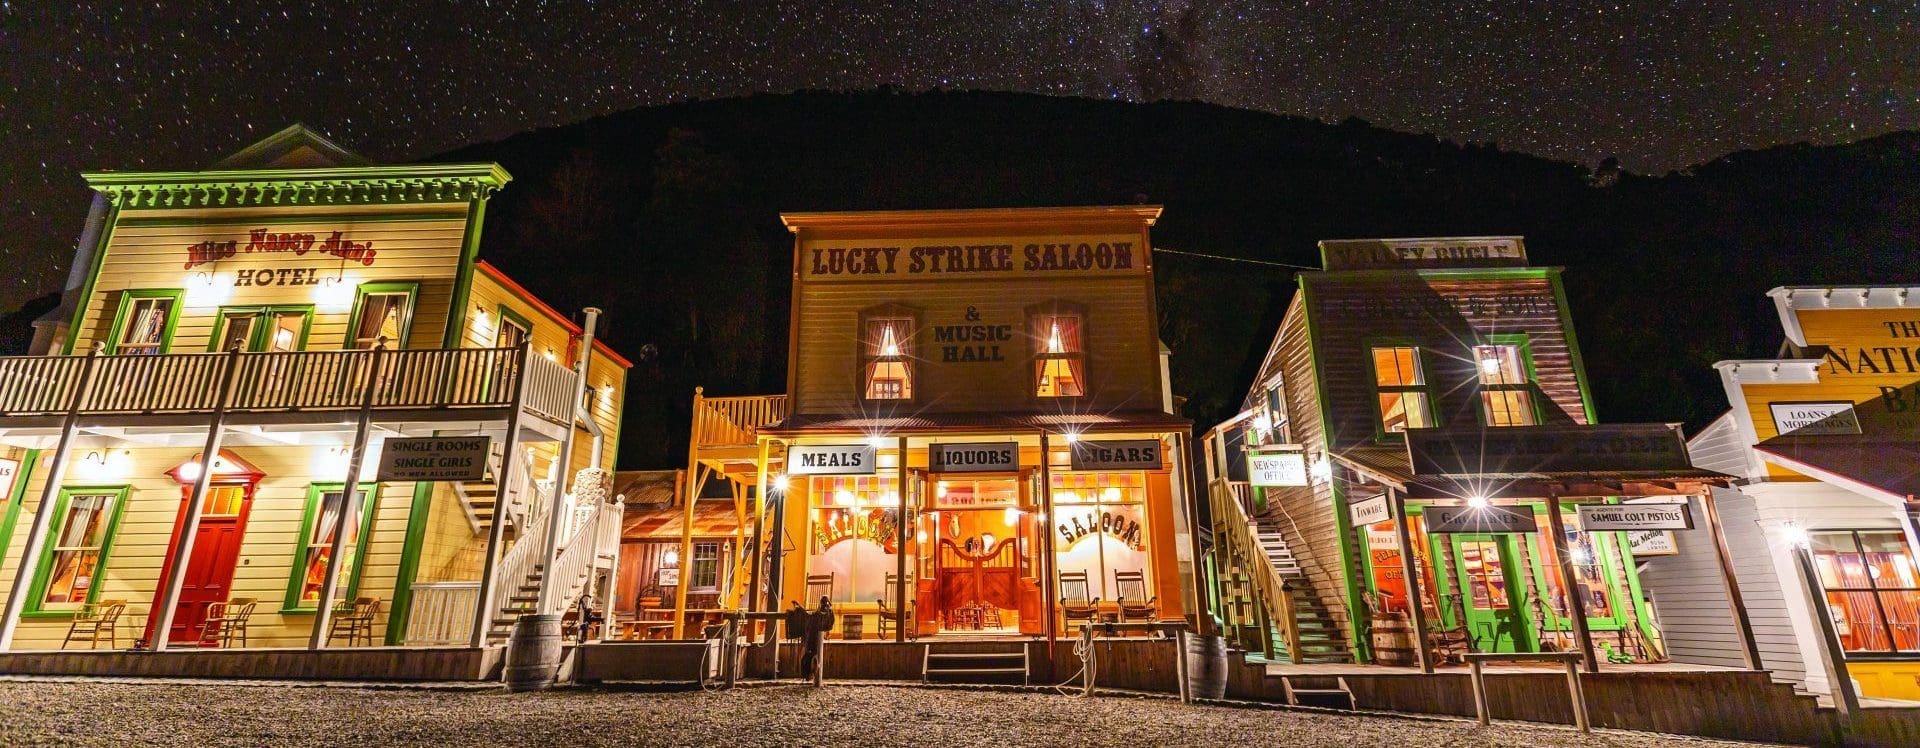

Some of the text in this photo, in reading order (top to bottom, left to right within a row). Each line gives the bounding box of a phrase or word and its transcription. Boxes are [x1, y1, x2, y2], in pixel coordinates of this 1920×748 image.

[184, 228, 377, 270] Miss Nancy Ann's
[811, 242, 1133, 275] LUCKY STRIKE SALOON
[234, 268, 319, 287] HOTEL
[965, 305, 981, 321] &
[934, 325, 1012, 343] MUSIC
[942, 345, 1005, 363] HALL
[1789, 411, 1828, 419] LOANS
[391, 440, 481, 451] SINGLE ROOMS
[394, 457, 472, 468] SINGLE GIRLS
[802, 453, 861, 467] MEALS
[935, 450, 1012, 466] LIQUORS
[1591, 512, 1681, 522] SAMUEL COLT PISTOLS
[1059, 512, 1141, 547] SALOON
